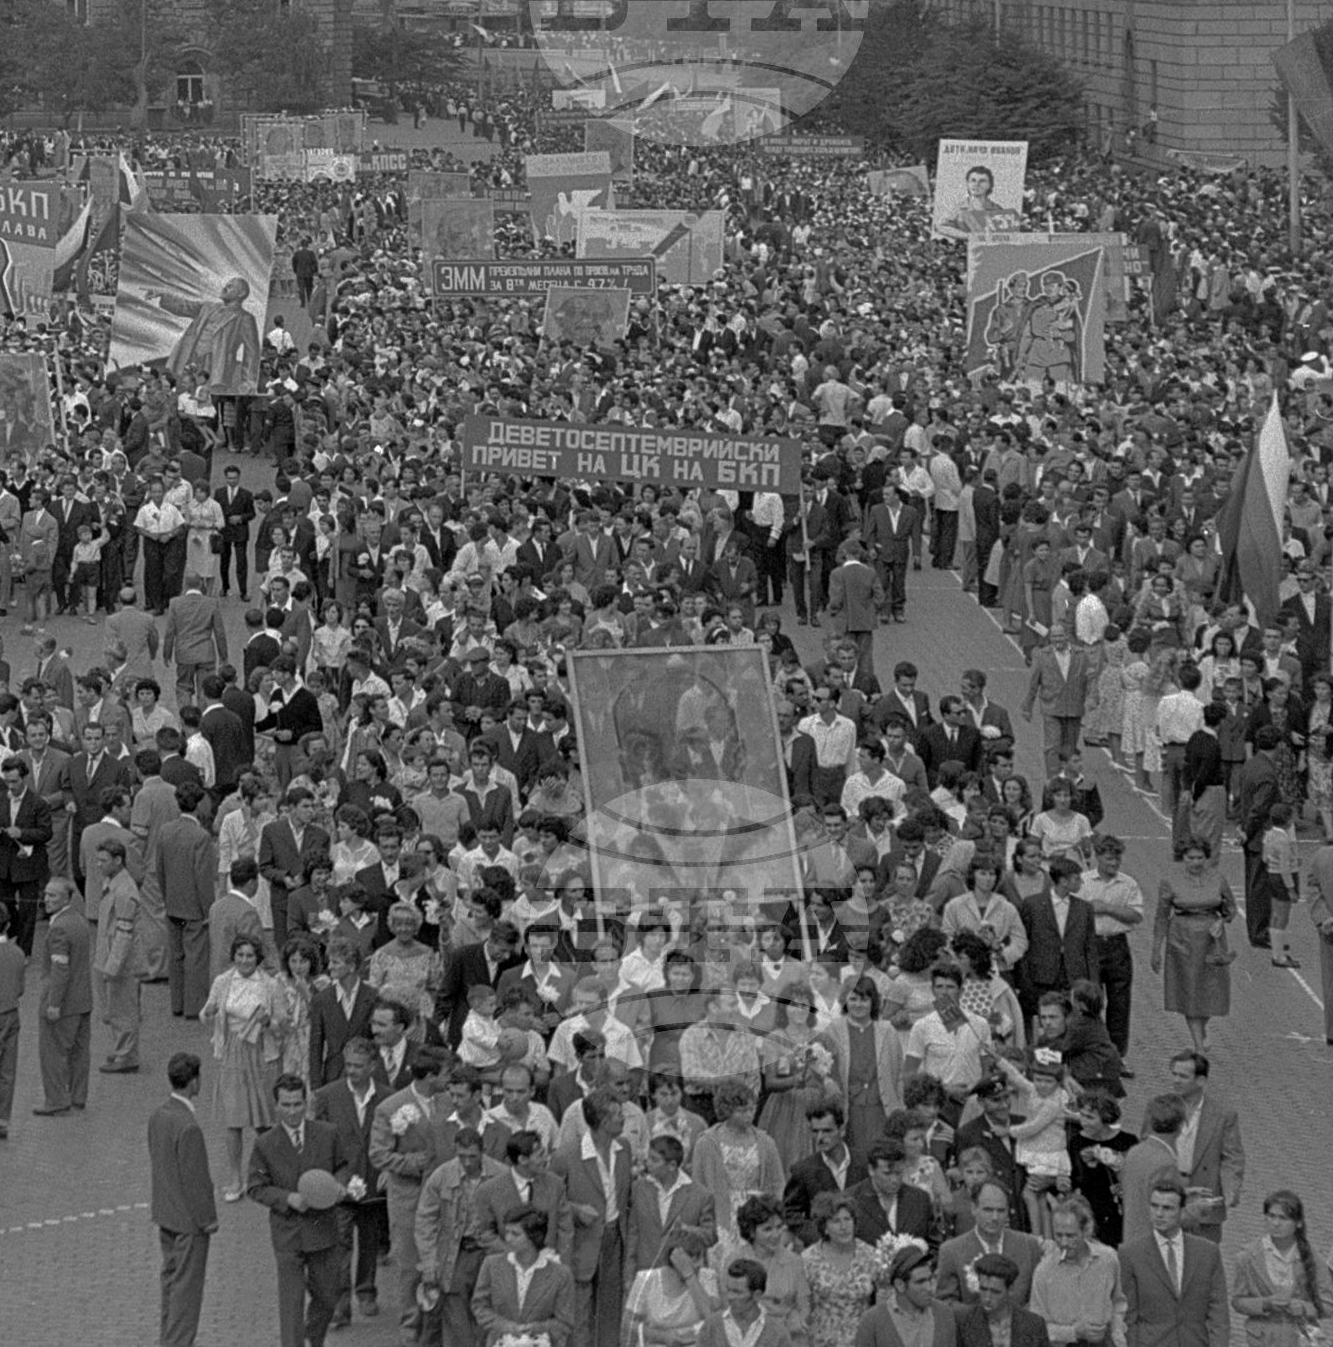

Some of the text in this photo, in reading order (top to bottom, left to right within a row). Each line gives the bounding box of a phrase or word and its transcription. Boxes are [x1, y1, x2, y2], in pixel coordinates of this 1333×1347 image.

[372, 154, 407, 170] КПСС
[441, 266, 485, 290] ЗММ
[490, 280, 502, 290] ЗА
[488, 421, 780, 462] ДЕВЕТОСЕПТЕМВРИЙСКИ
[472, 445, 781, 487] ПРИВЕТ НА ЦК НА БКП
